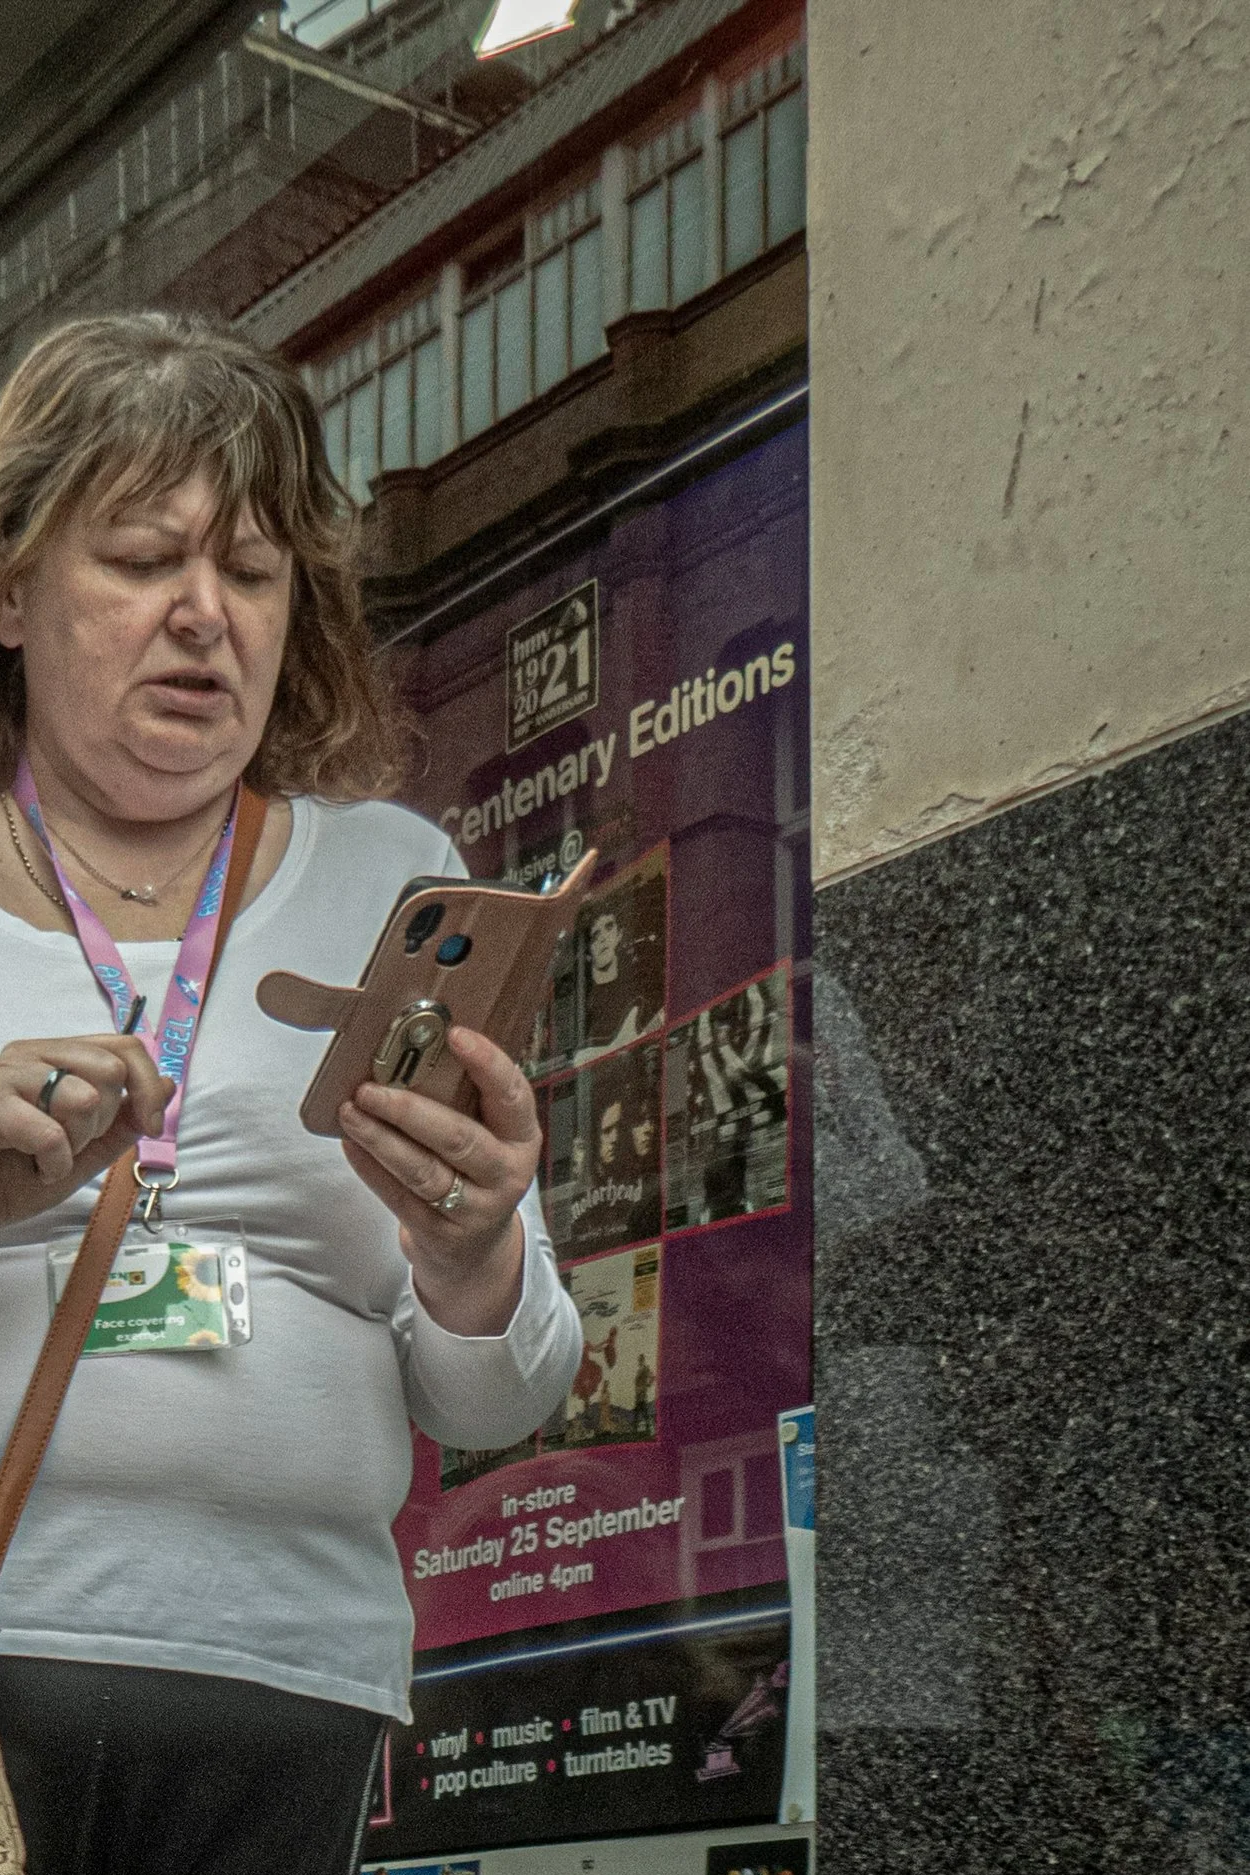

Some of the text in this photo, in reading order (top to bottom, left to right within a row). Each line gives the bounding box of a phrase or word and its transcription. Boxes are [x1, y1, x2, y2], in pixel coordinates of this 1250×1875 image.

[630, 643, 796, 758] Editions
[96, 1315, 185, 1329] Face covering
[115, 1330, 167, 1342] exempt
[501, 1483, 577, 1519] in-store
[414, 1496, 686, 1580] Saturday 25 September
[490, 1560, 594, 1602] online 4pm
[431, 1696, 676, 1760] vinyl music film & TV
[434, 1740, 673, 1800] pop culture turntables
